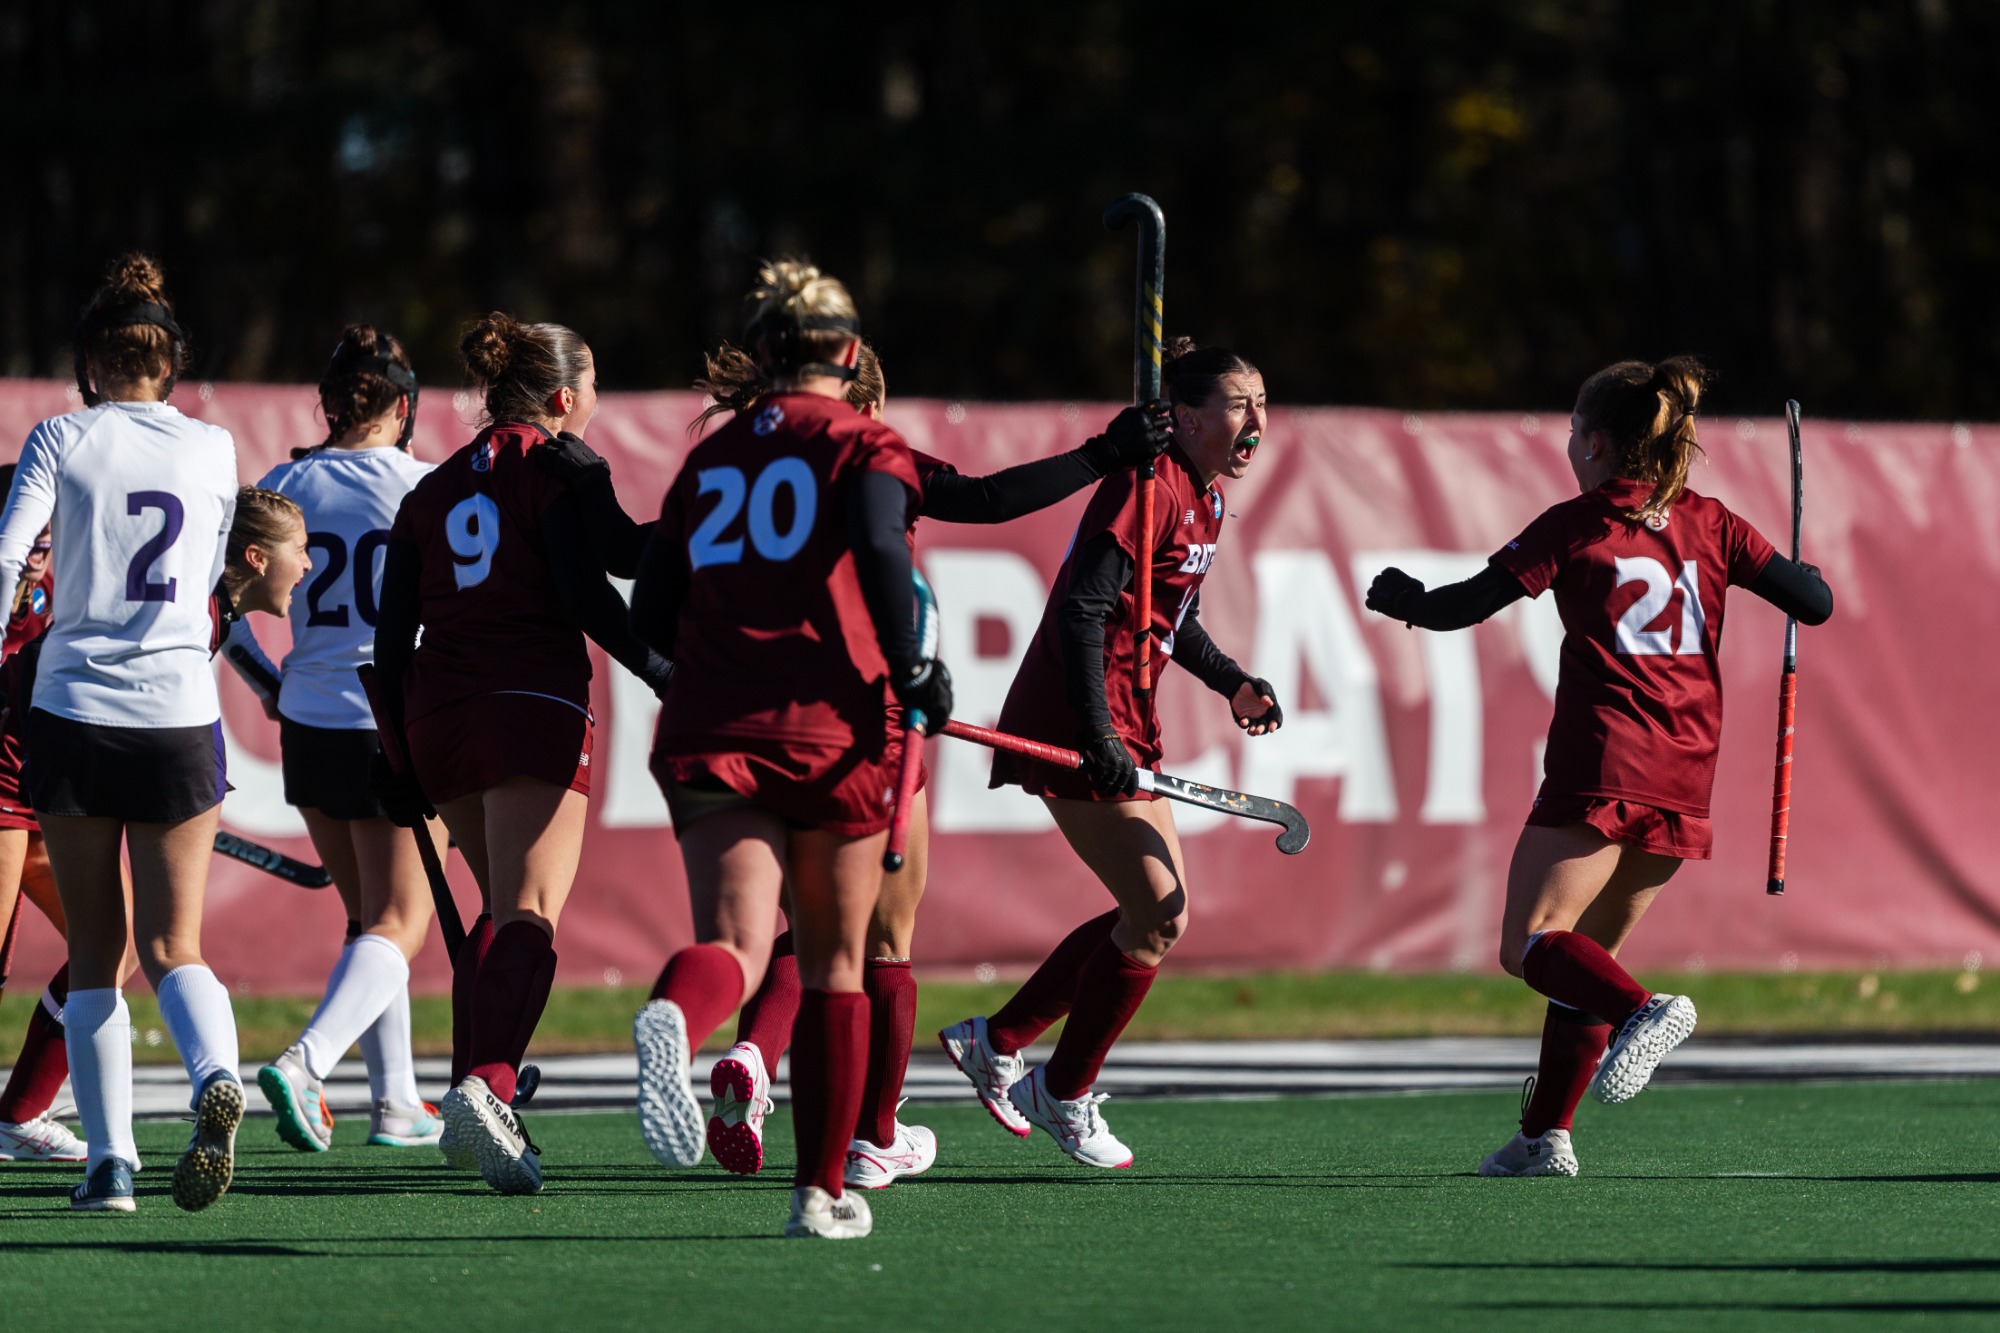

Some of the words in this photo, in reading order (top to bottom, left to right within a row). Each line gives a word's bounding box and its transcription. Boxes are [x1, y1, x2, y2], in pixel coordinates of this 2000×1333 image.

[125, 490, 185, 603] 2
[444, 491, 499, 592] 9
[688, 456, 818, 573] 20
[1179, 543, 1217, 575] BAT
[1614, 556, 1705, 656] 21
[486, 1093, 521, 1140] OSAKA
